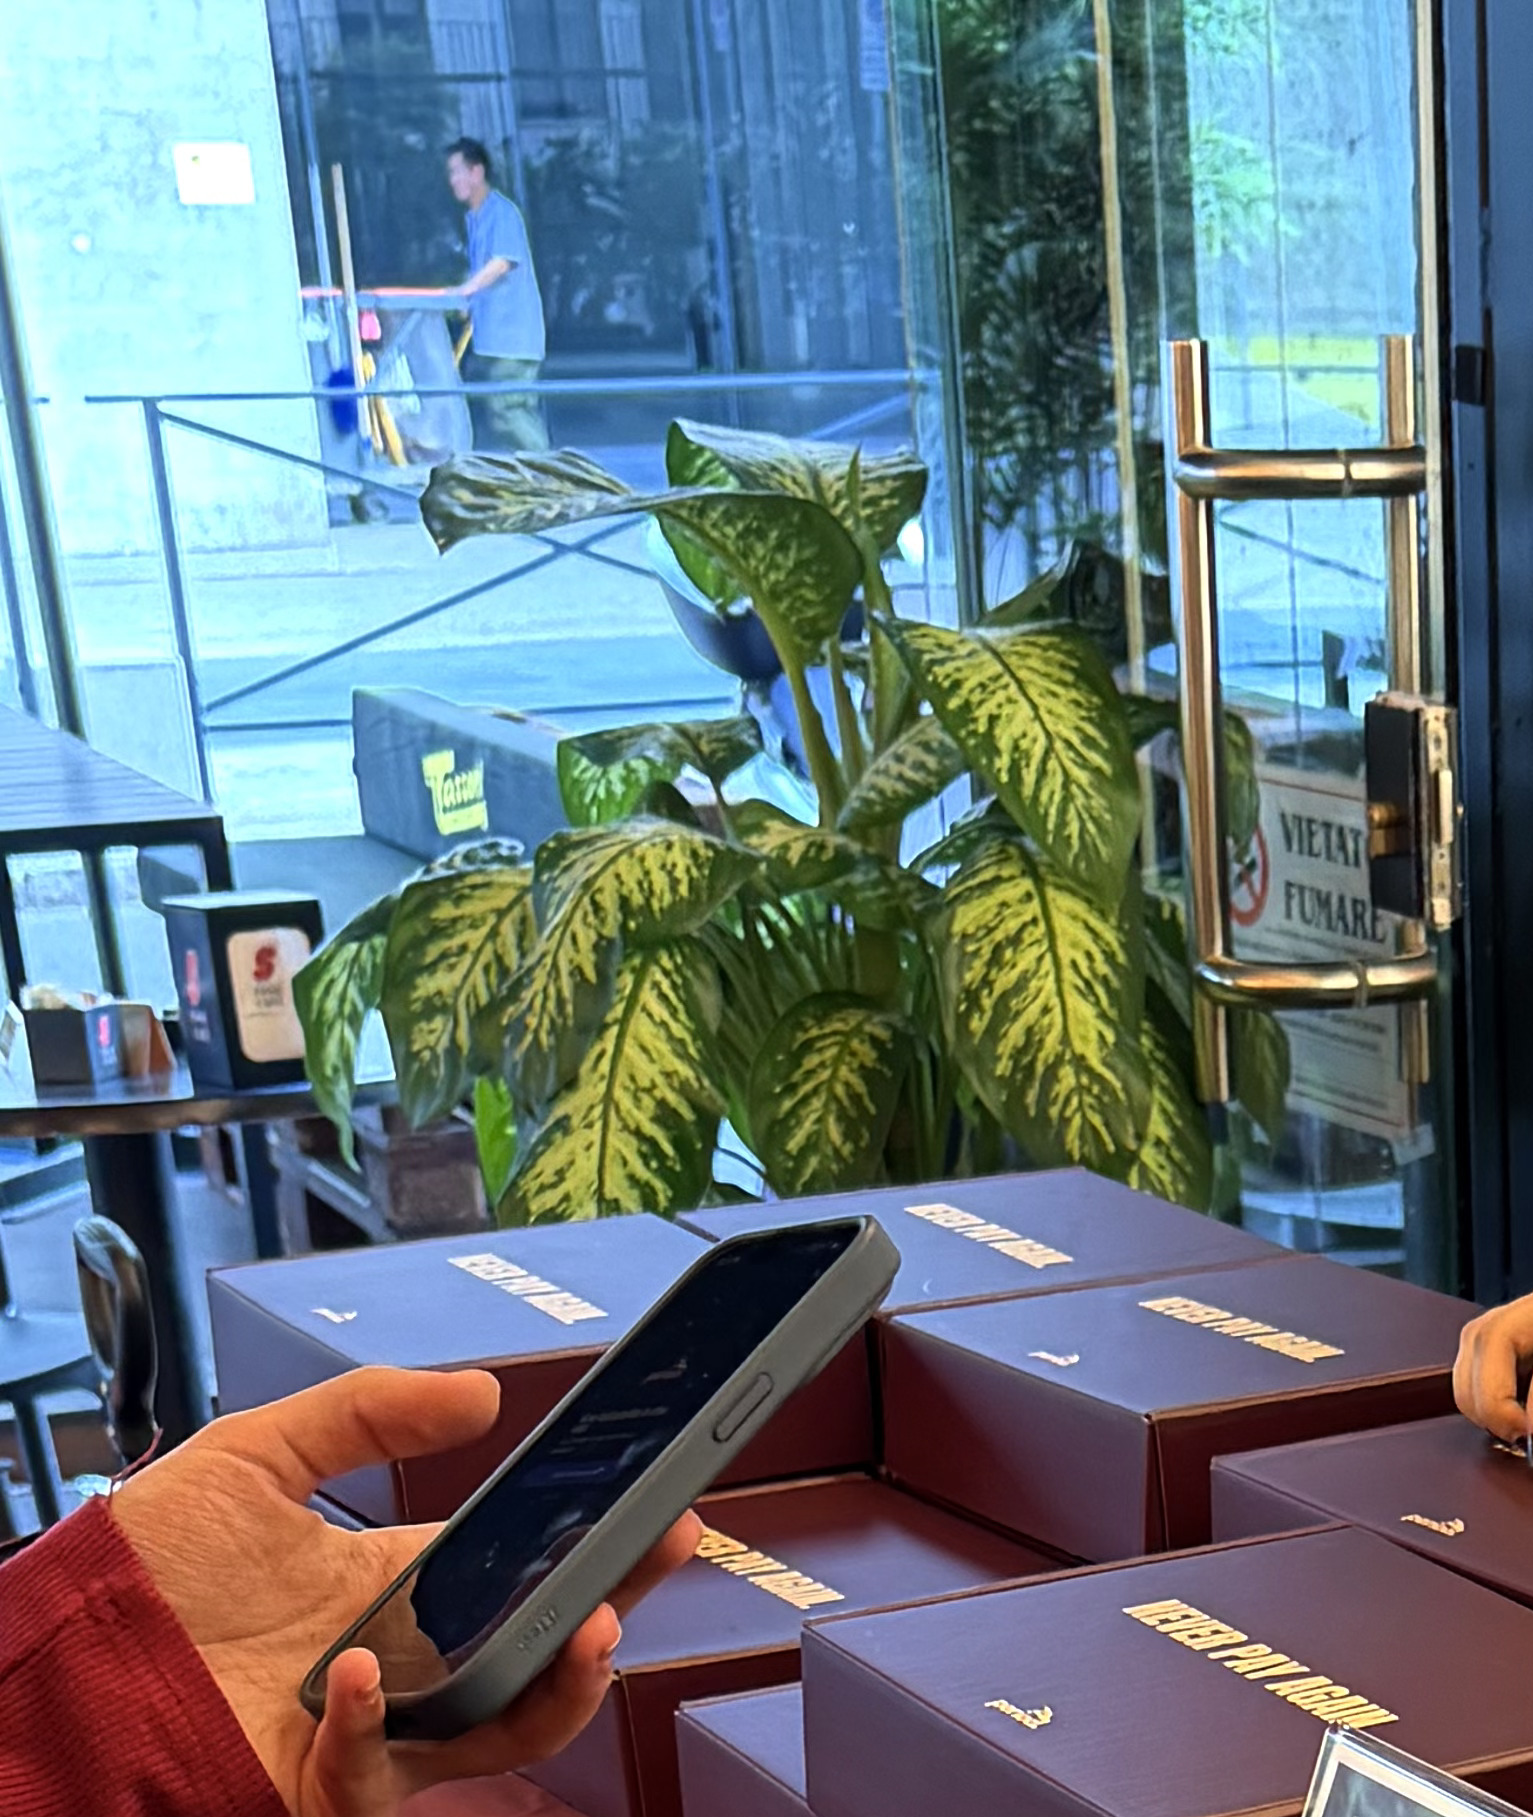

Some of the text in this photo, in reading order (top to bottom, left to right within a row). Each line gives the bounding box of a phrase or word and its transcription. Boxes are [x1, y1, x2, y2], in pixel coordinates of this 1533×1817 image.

[1280, 808, 1363, 869] VIETAT
[1284, 879, 1387, 944] FUMARE
[1122, 1598, 1249, 1651] NEVER
[1207, 1642, 1311, 1681] PAY
